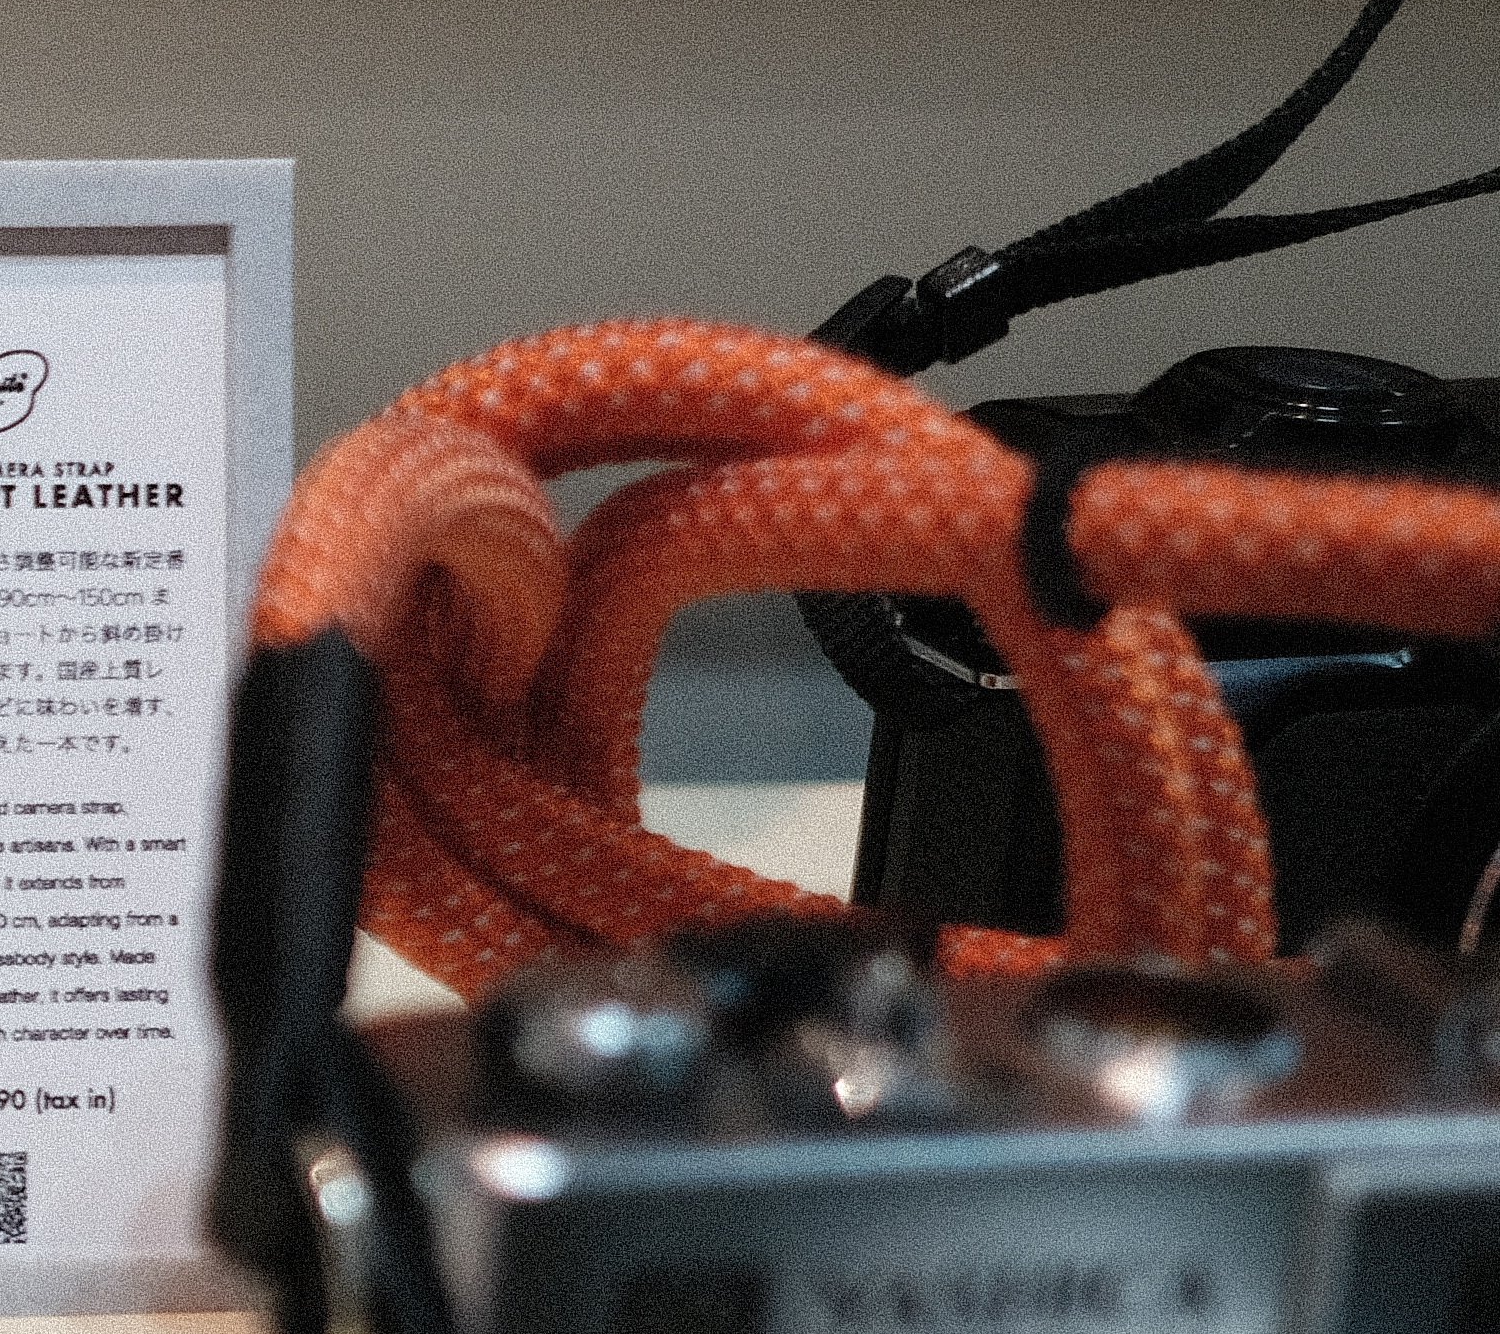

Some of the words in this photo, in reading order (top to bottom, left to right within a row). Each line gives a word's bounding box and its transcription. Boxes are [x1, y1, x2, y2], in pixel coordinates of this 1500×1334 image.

[54, 460, 117, 480] STRAP
[33, 483, 187, 511] LEATHER
[14, 802, 78, 817] camera
[84, 835, 122, 854] With
[126, 839, 137, 854] a
[141, 838, 188, 854] smart
[4, 877, 15, 893] it
[18, 876, 85, 893] extends
[89, 875, 127, 892] from
[48, 912, 123, 932] adapting
[126, 911, 165, 929] from
[168, 914, 181, 929] a
[110, 949, 158, 967] Made
[50, 990, 61, 1005] it
[63, 986, 112, 1005] offers
[116, 988, 171, 1008] lasting
[12, 1026, 92, 1044] character
[95, 1027, 132, 1042] over
[35, 1087, 82, 1116] (tax
[88, 1086, 117, 1116] in)
